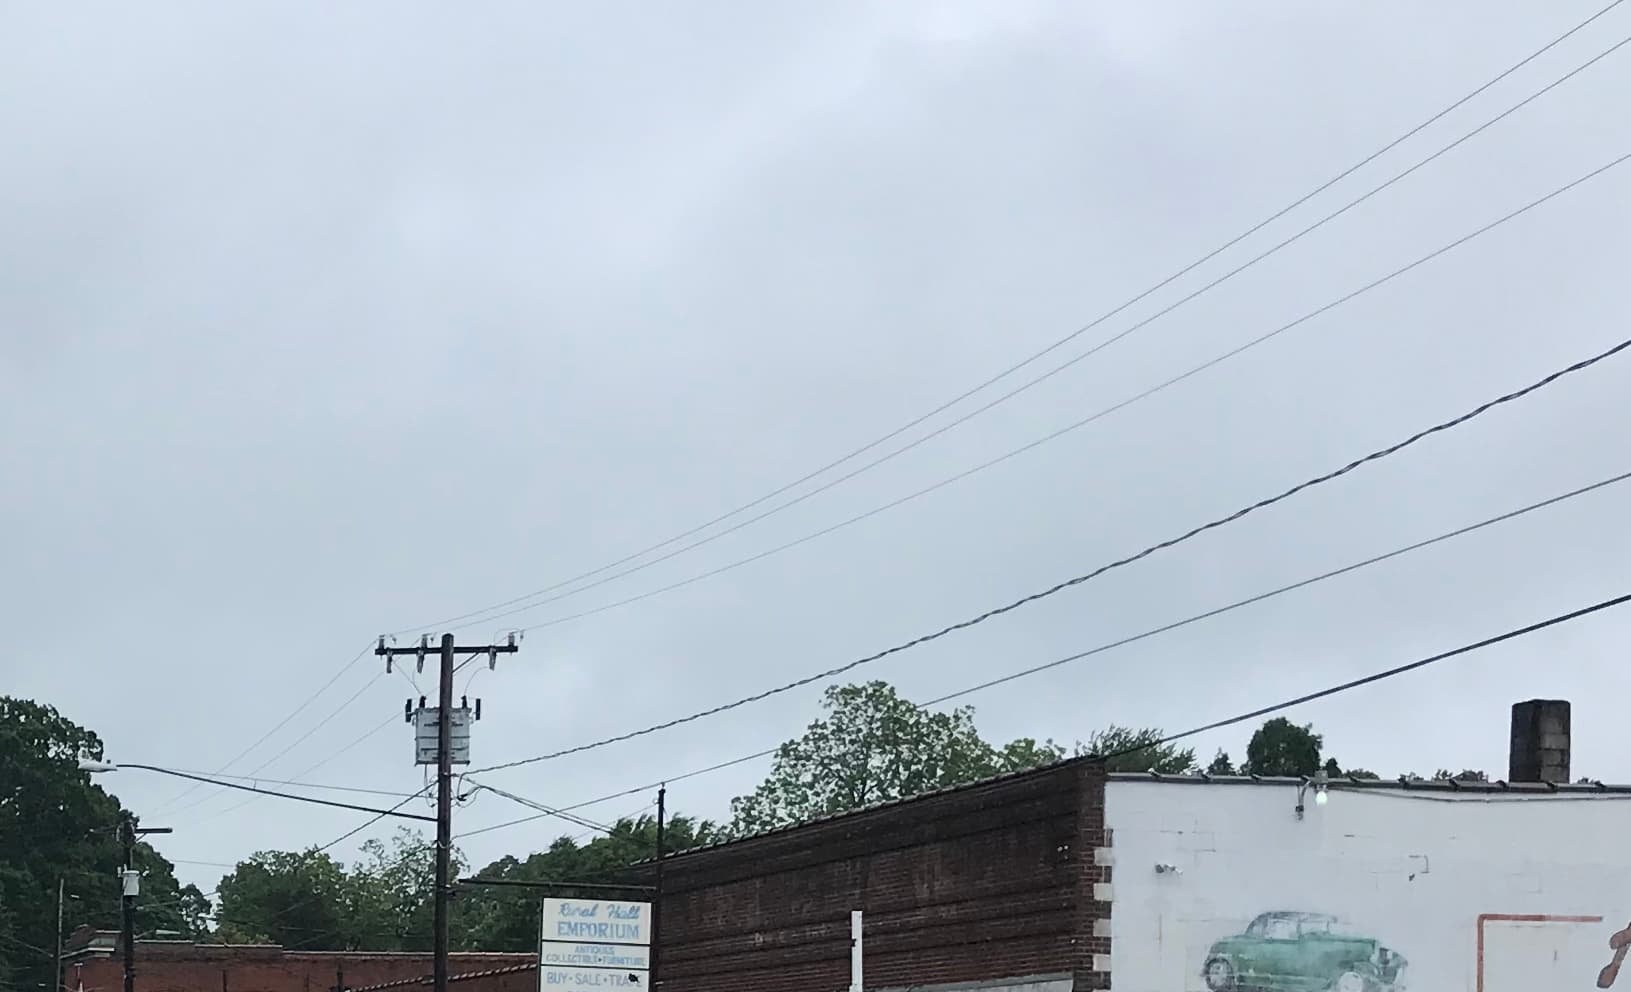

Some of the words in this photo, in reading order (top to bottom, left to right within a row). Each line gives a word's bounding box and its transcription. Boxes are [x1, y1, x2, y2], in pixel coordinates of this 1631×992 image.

[557, 921, 640, 940] EMPORIUM
[546, 973, 568, 985] BUY
[609, 975, 643, 988] TRAE
